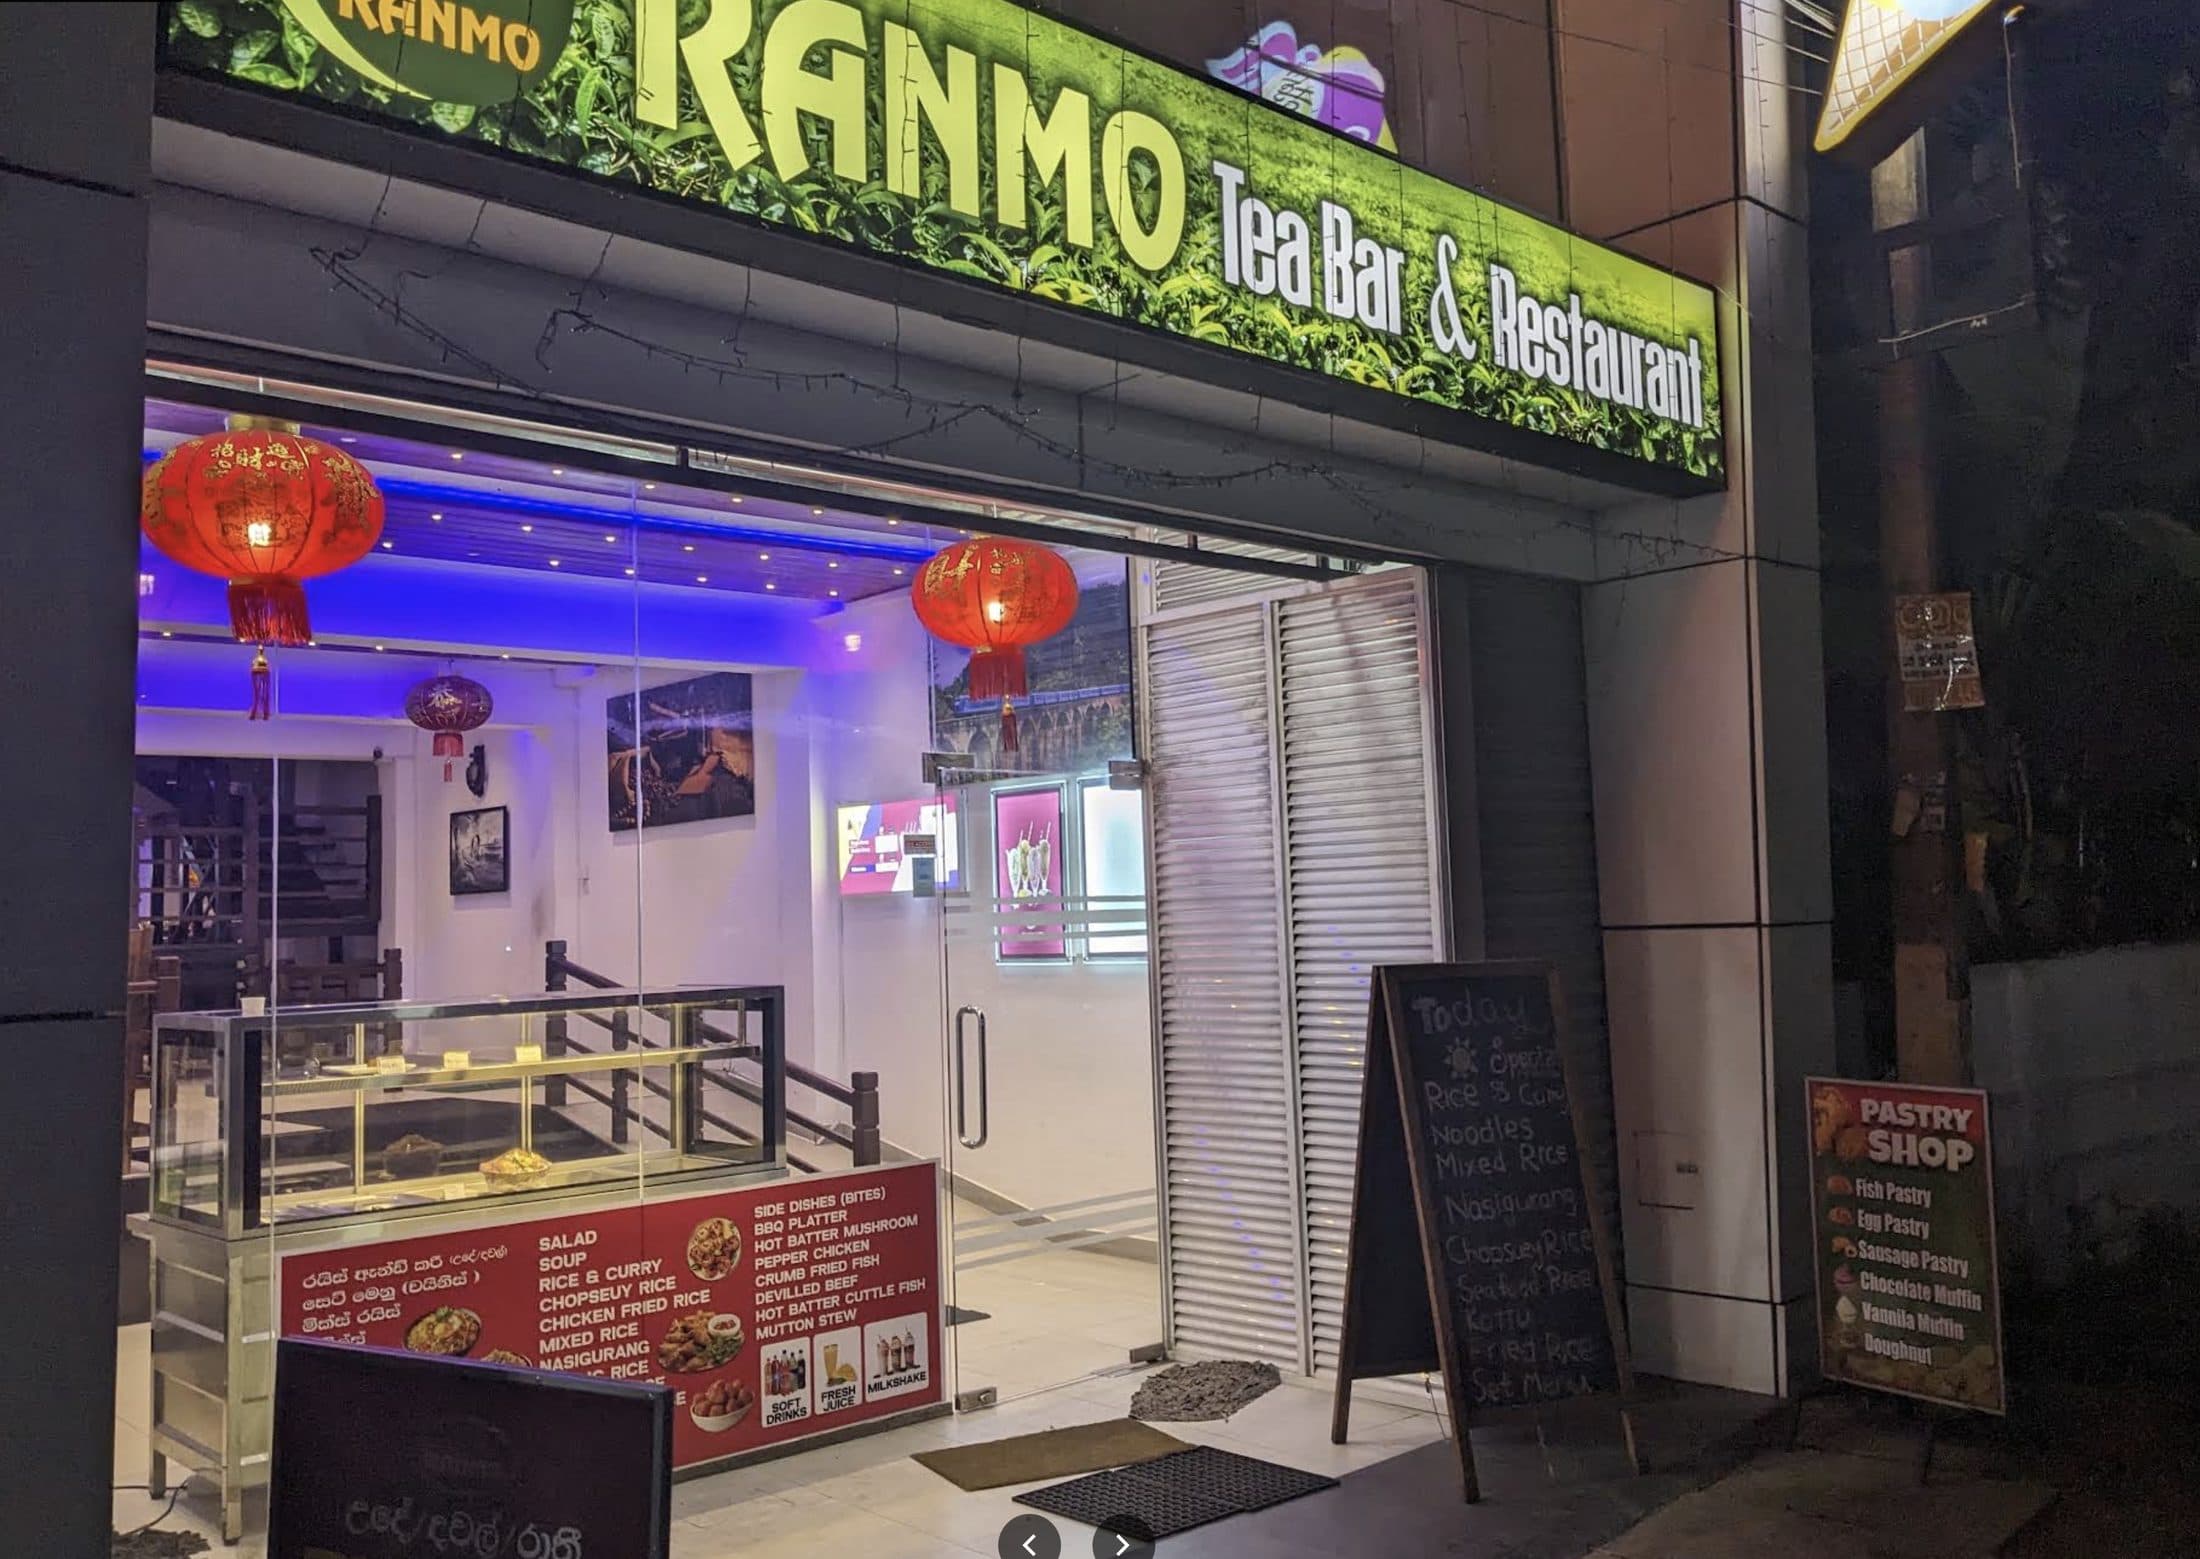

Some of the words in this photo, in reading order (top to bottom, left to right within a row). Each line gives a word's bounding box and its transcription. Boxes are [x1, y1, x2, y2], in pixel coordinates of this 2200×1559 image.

[636, 0, 1186, 271] RANMO
[1213, 160, 1311, 307] Tea
[1322, 201, 1404, 336] Bar
[1430, 234, 1477, 360] &
[1490, 264, 1702, 428] Restaurant
[1411, 984, 1528, 1039] Today
[1490, 1036, 1562, 1079] Specia
[1424, 1081, 1479, 1113] Rice
[1430, 1114, 1534, 1145] Noodles
[1860, 1098, 1973, 1132] PASTRY
[1436, 1151, 1507, 1180] Mixed
[1519, 1143, 1568, 1172] Rice
[1868, 1129, 1974, 1171] SHOP
[754, 1203, 785, 1218] SIDE
[789, 1195, 836, 1213] DISHES
[840, 1186, 886, 1207] (BITES)
[1856, 1178, 1884, 1200] Fish
[1886, 1182, 1931, 1208] Pastry
[754, 1221, 784, 1236] BBQ
[788, 1210, 847, 1231] PLATTER
[754, 1238, 783, 1253] HOT
[788, 1228, 839, 1248] BATTER
[844, 1214, 918, 1237] MUSHROOM
[1857, 1209, 1882, 1233] Egg
[1884, 1213, 1929, 1240] Pastry
[539, 1230, 597, 1251] SALAD
[755, 1250, 808, 1270] PEPPER
[813, 1239, 870, 1260] CHICKEN
[539, 1252, 587, 1272] SOUP
[539, 1273, 579, 1292] RICE
[586, 1270, 599, 1284] &
[605, 1258, 662, 1281] CURRY
[755, 1268, 805, 1287] CRUMB
[810, 1260, 847, 1278] FRIED
[852, 1254, 880, 1270] FISH
[1858, 1239, 1919, 1269] Sausage
[1921, 1250, 1969, 1279] Pastry
[539, 1284, 632, 1312] CHOPSEUY
[639, 1276, 676, 1296] RICE
[755, 1283, 820, 1305] DEVILLED
[825, 1275, 858, 1290] BEEF
[755, 1306, 784, 1322] HOT
[789, 1296, 839, 1316] BATTER
[845, 1284, 894, 1304] CUTTLE
[899, 1278, 926, 1294] FISH
[1860, 1271, 1931, 1301] Chocolate
[1934, 1284, 1982, 1312] Muffin
[539, 1306, 615, 1333] CHICKEN
[621, 1297, 667, 1319] FRIED
[673, 1289, 711, 1309] RICE
[756, 1318, 814, 1340] MUTTON
[819, 1308, 857, 1326] STEW
[1917, 1313, 1964, 1340] Muffin
[539, 1332, 594, 1354] MIXED
[600, 1322, 639, 1342] RICE
[1864, 1333, 1932, 1366] Doughnut
[539, 1340, 650, 1371] NASIGURANG
[611, 1360, 649, 1380] RICE
[821, 1385, 856, 1403] FRESH
[867, 1371, 926, 1394] MILKSHAKE
[766, 1407, 807, 1425] DRINKS
[772, 1398, 800, 1413] SOFT
[823, 1396, 854, 1412] JUICE
